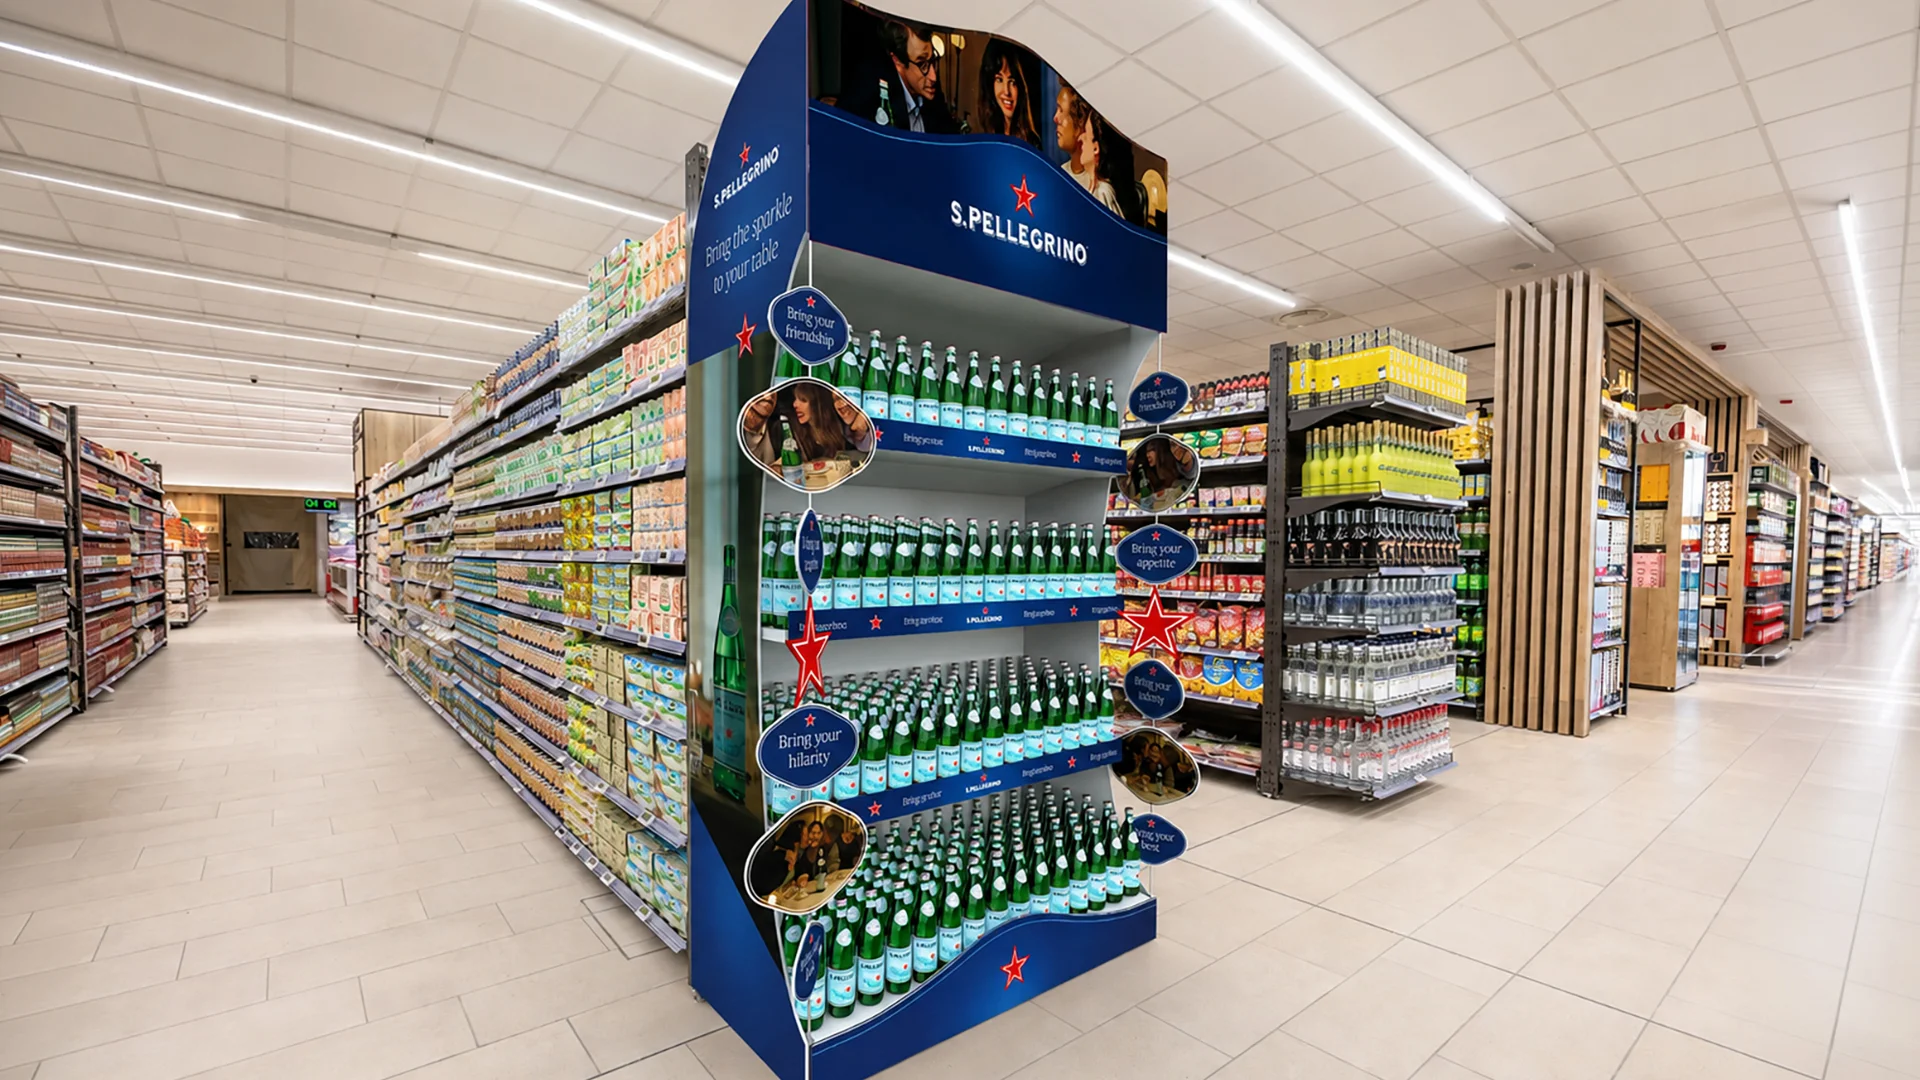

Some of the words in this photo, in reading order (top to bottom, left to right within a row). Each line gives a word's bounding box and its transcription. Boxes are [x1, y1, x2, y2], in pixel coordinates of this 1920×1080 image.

[714, 145, 779, 209] S.PELLEGRINO
[706, 240, 732, 268] Bring
[733, 225, 750, 250] the
[752, 192, 793, 241] sparkle
[951, 200, 1088, 266] S.PELLEGRINO
[713, 274, 724, 294] to
[725, 259, 750, 294] your
[752, 238, 779, 273] table
[787, 306, 813, 328] Bring
[813, 316, 835, 331] your
[785, 323, 835, 351] friendship
[1131, 542, 1157, 557] Bring
[1159, 545, 1183, 557] your
[1136, 559, 1176, 571] appetite
[778, 732, 812, 750] Bring
[814, 729, 842, 748] your
[788, 748, 831, 769] hilarity
[1155, 832, 1175, 843] your
